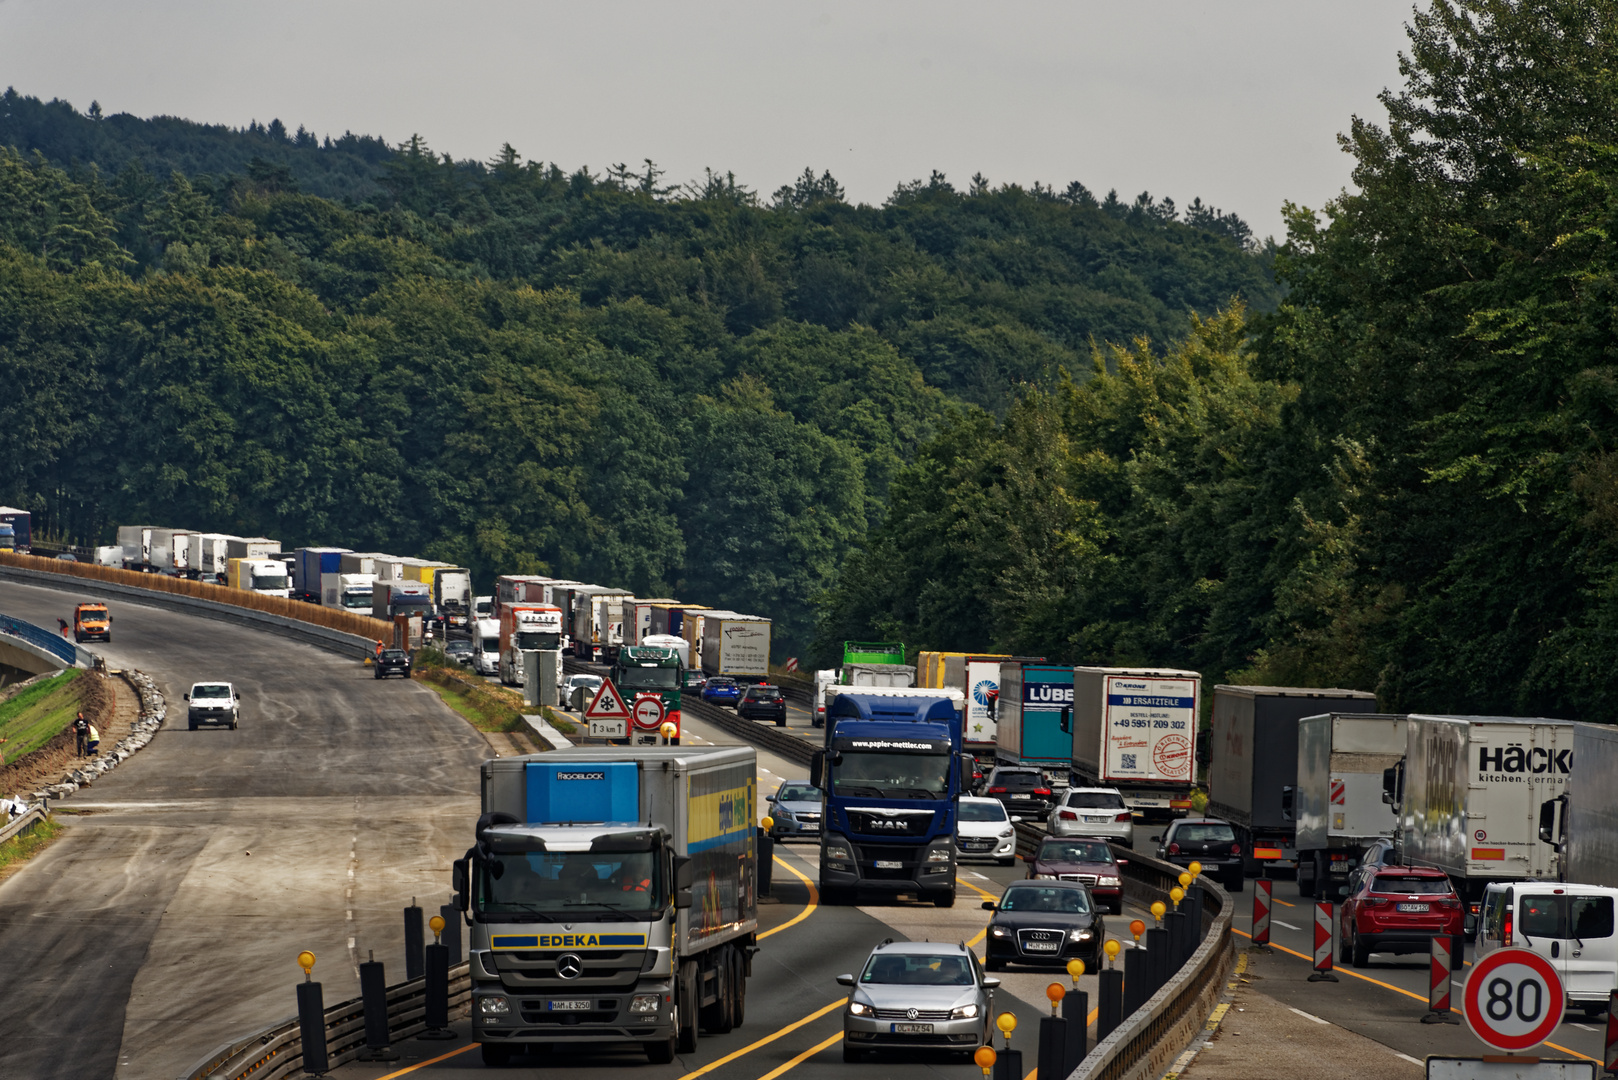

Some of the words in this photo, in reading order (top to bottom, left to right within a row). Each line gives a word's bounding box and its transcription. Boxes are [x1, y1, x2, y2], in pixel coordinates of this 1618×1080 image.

[1133, 697, 1179, 706] ERSATZTEILE
[1113, 719, 1130, 728] +49
[1131, 719, 1151, 728] 5951
[1153, 720, 1169, 729] 209
[1170, 721, 1186, 729] 302
[599, 725, 604, 733] 3
[606, 725, 616, 733] km
[852, 740, 932, 750] www.papier-mettler.com
[1166, 751, 1188, 759] KRONE
[557, 771, 604, 780] FRIGOBLOCK
[870, 819, 908, 830] MAN
[540, 934, 598, 947] EDEKA
[552, 1001, 566, 1009] HAM
[574, 1000, 590, 1009] 3250
[1486, 977, 1543, 1023] 80
